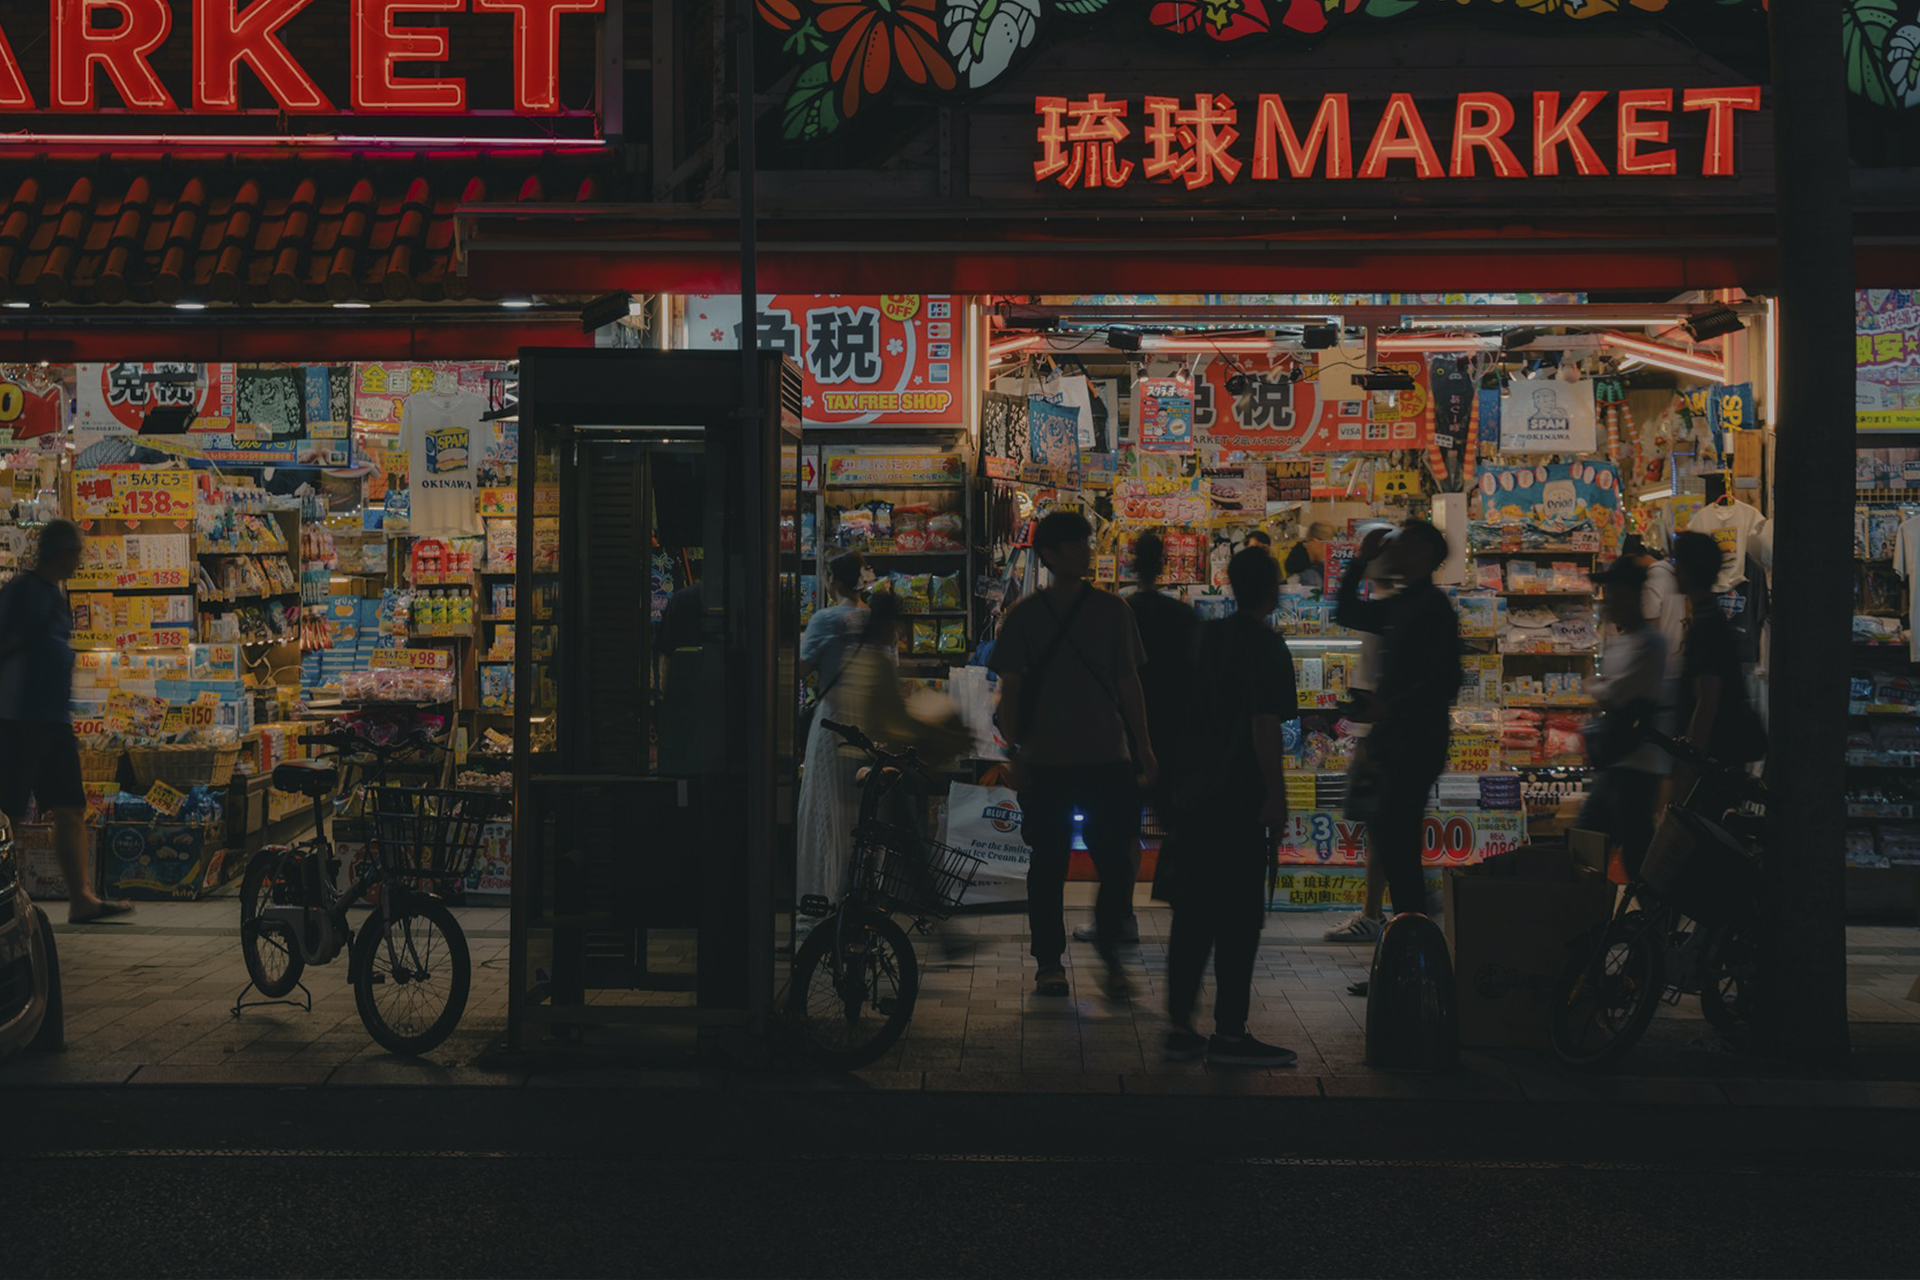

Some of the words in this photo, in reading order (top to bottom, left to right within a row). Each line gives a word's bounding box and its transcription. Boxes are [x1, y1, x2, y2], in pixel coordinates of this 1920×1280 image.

[886, 304, 912, 317] OFF
[826, 394, 856, 410] TAX
[858, 394, 898, 410] FREE
[901, 393, 949, 410] SHOP
[1530, 418, 1567, 429] SPAM
[1340, 427, 1361, 436] VISA
[437, 433, 469, 450] SPAM
[130, 473, 180, 486] ちんすこう
[421, 480, 472, 490] OKINAWA
[116, 572, 137, 586] 半額
[152, 572, 181, 584] 138
[115, 633, 137, 647] 半額
[152, 632, 181, 645] 138
[409, 652, 436, 666] ¥98
[1461, 749, 1490, 757] ¥1408
[1454, 760, 1488, 771] ¥2565
[986, 808, 1008, 820] BLUE
[971, 839, 988, 849] For
[988, 841, 1002, 851] the
[973, 849, 986, 858] Ice
[988, 851, 1017, 862] Cream
